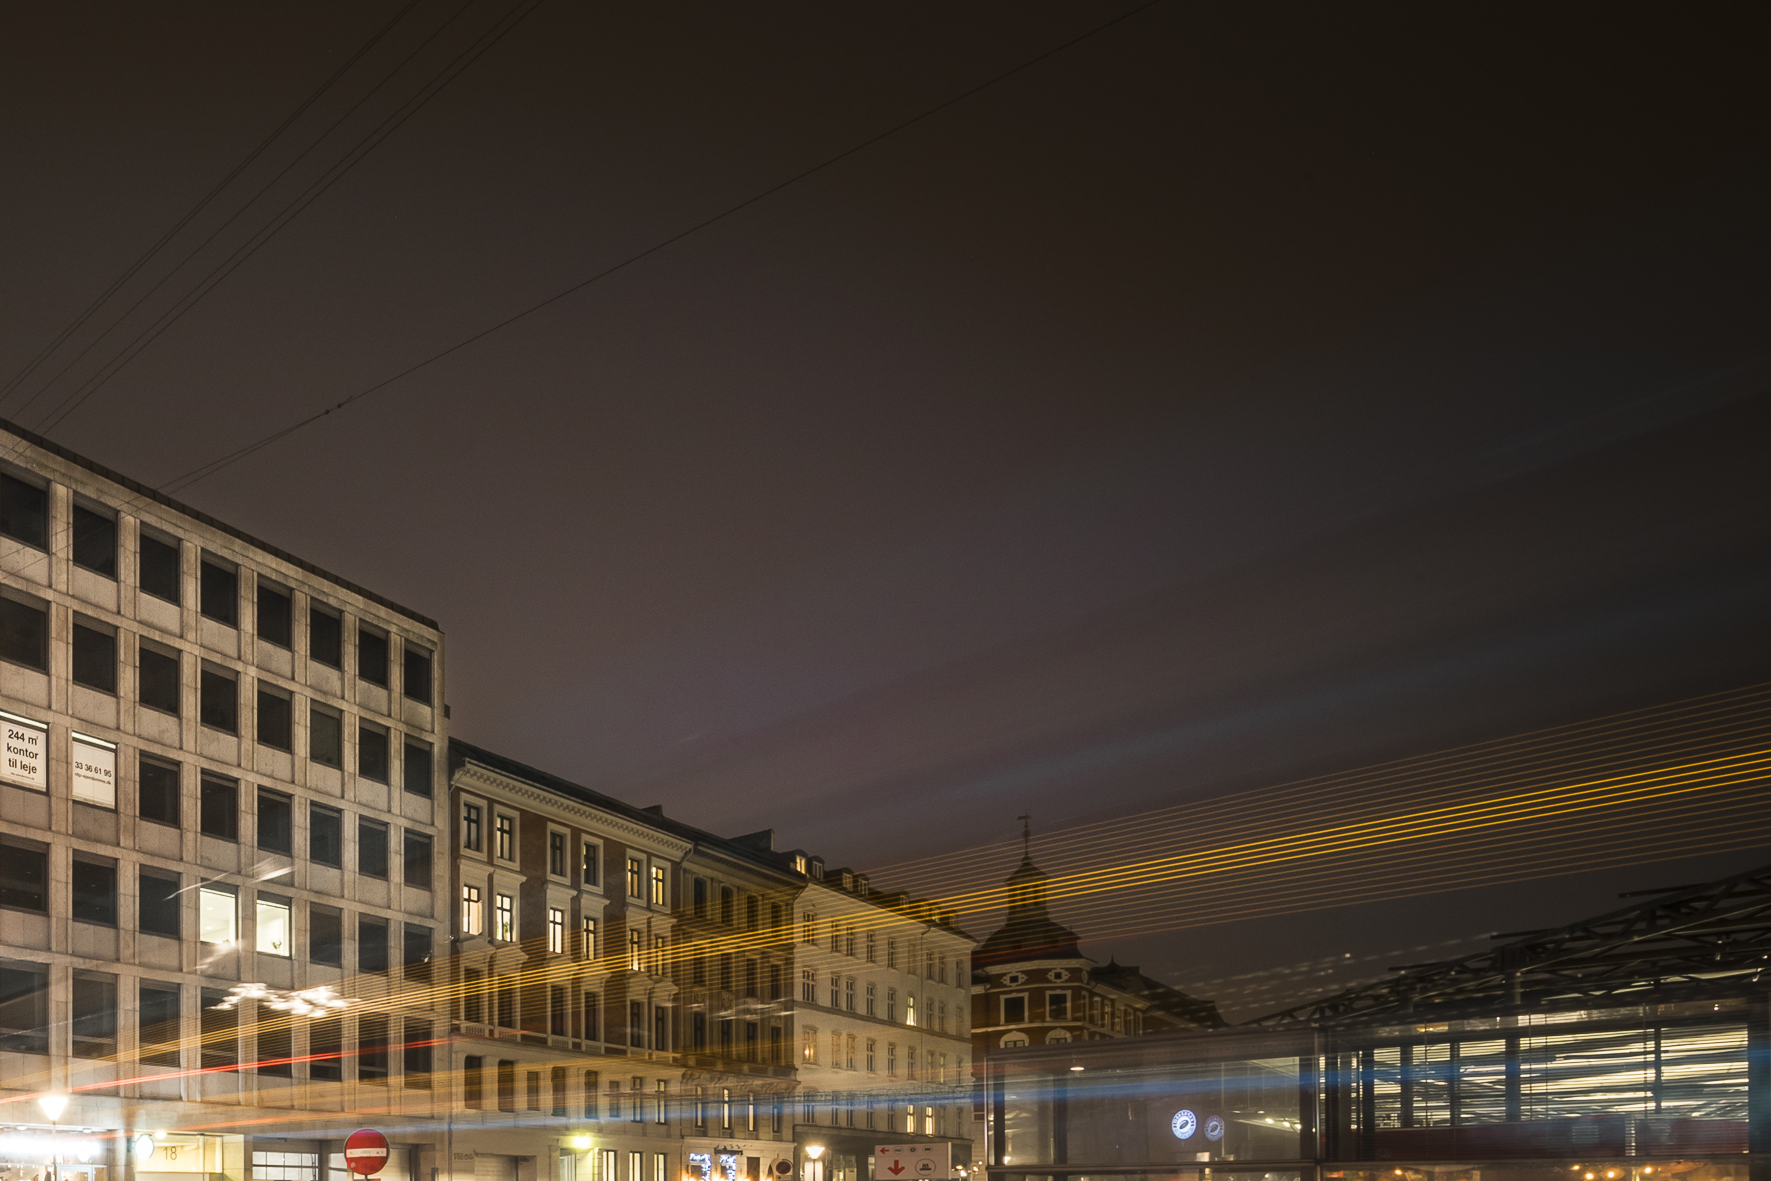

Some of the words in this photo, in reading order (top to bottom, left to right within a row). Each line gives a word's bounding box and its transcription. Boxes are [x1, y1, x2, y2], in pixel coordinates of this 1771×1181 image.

[8, 729, 25, 742] 244
[6, 742, 39, 760] kontor
[8, 758, 18, 769] til
[20, 760, 37, 775] leje
[74, 761, 84, 770] 33
[84, 764, 93, 773] 36
[94, 766, 102, 775] 61
[103, 769, 112, 778] 95
[163, 1146, 177, 1160] 18
